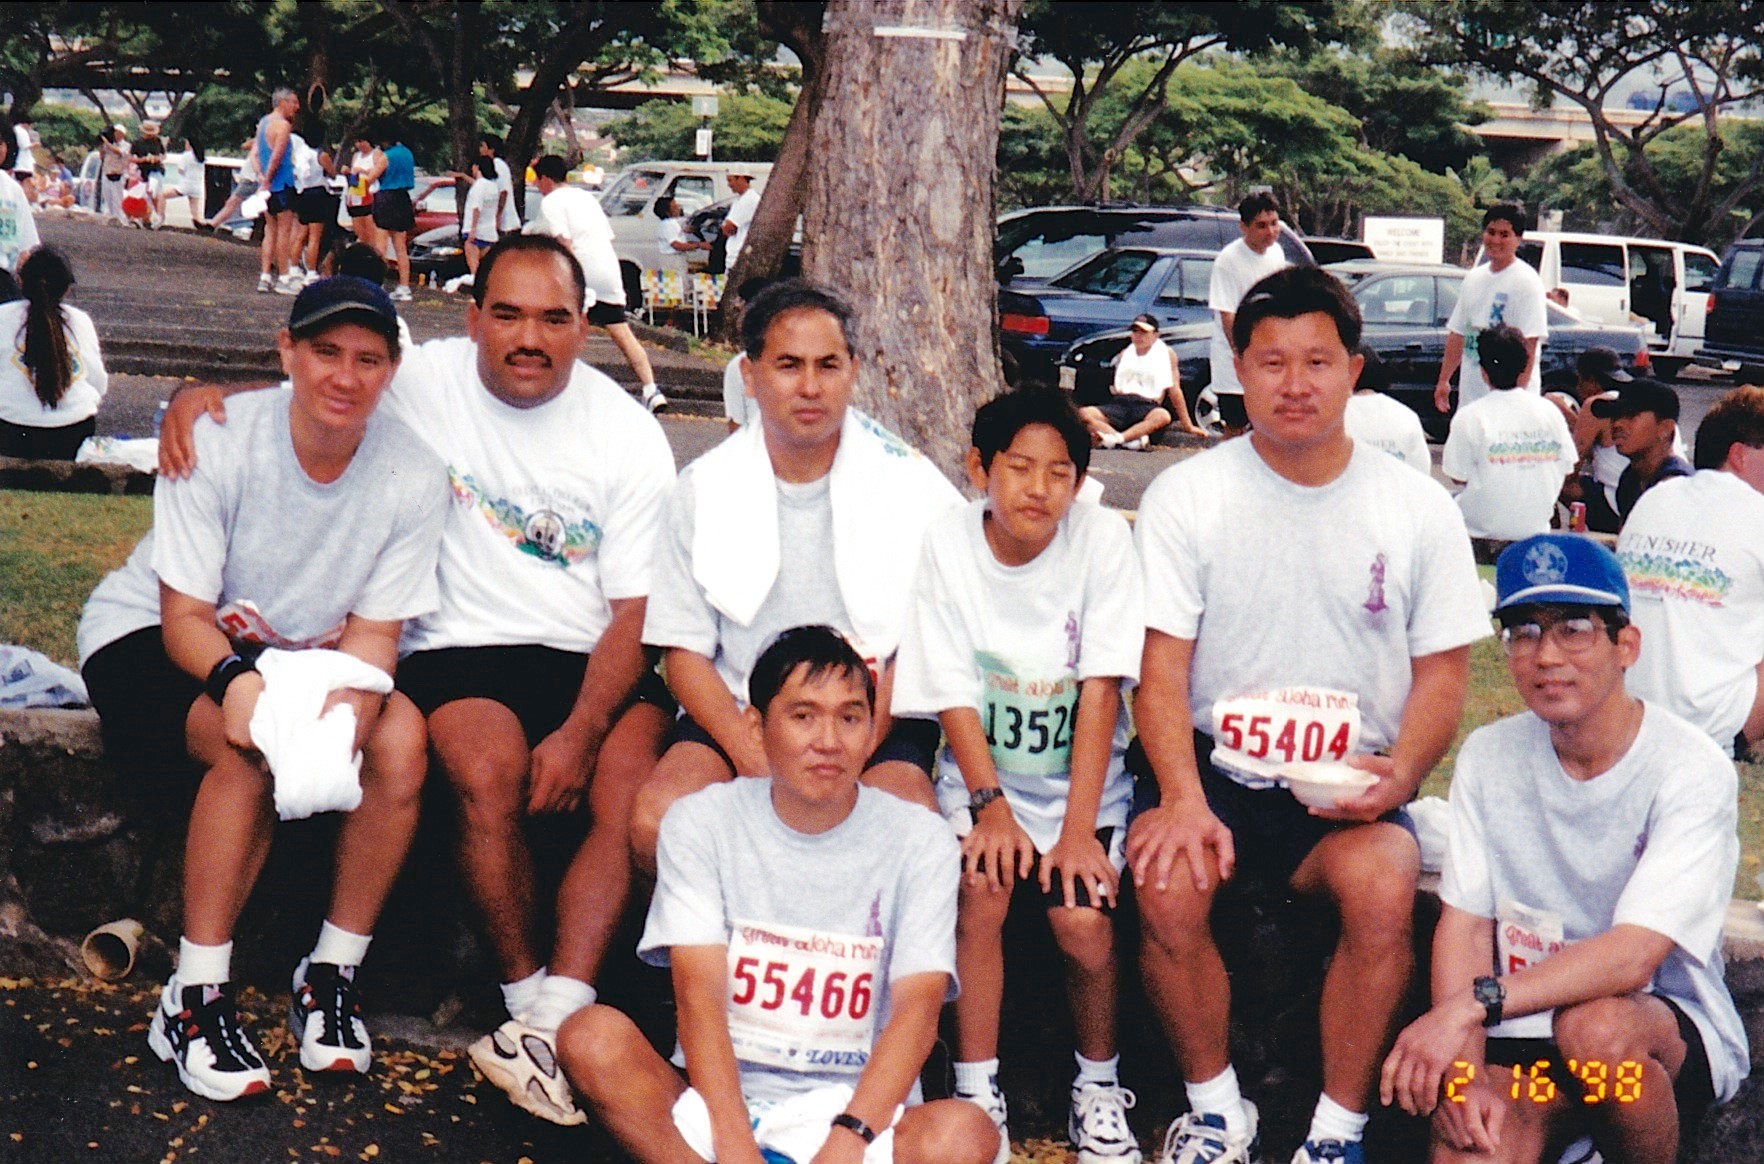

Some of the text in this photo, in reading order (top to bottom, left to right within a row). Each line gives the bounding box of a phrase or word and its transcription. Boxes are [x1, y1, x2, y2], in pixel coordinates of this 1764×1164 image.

[1387, 228, 1421, 237] WELCOME
[1627, 533, 1717, 562] FINISHER
[1221, 713, 1350, 763] 55404
[795, 934, 846, 958] aloha
[733, 956, 874, 1020] 55466
